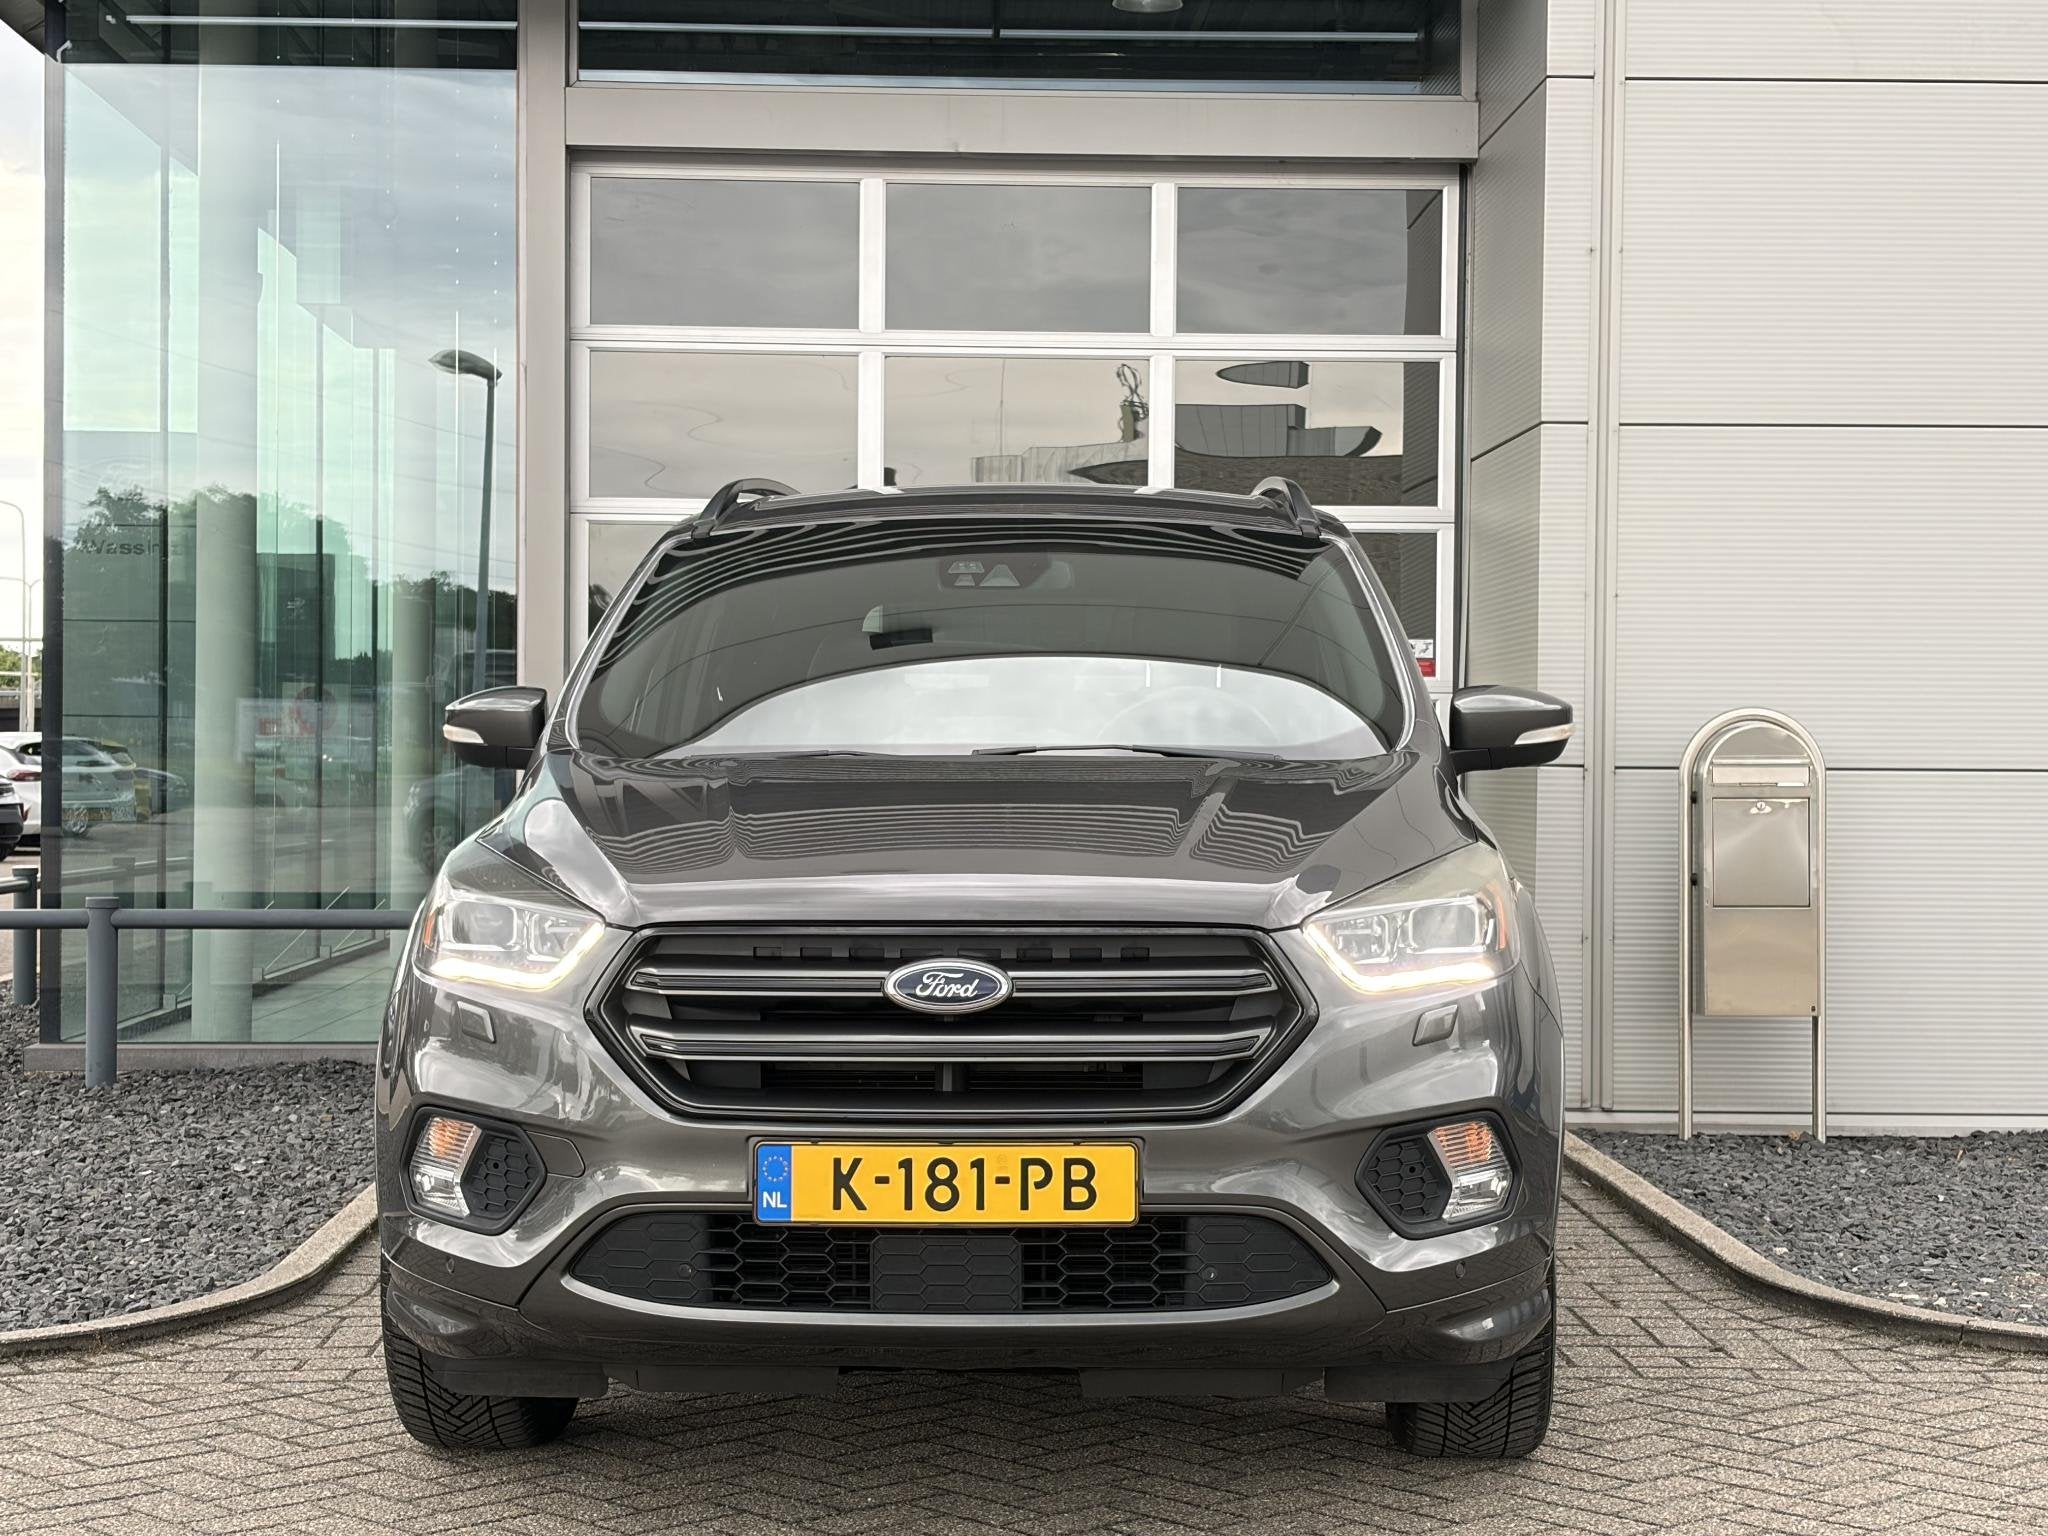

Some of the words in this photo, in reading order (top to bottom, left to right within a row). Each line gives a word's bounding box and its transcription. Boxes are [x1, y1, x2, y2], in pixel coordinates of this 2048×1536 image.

[915, 971, 979, 997] Ford
[832, 1157, 1097, 1212] K-181-PB
[762, 1192, 787, 1208] NL
